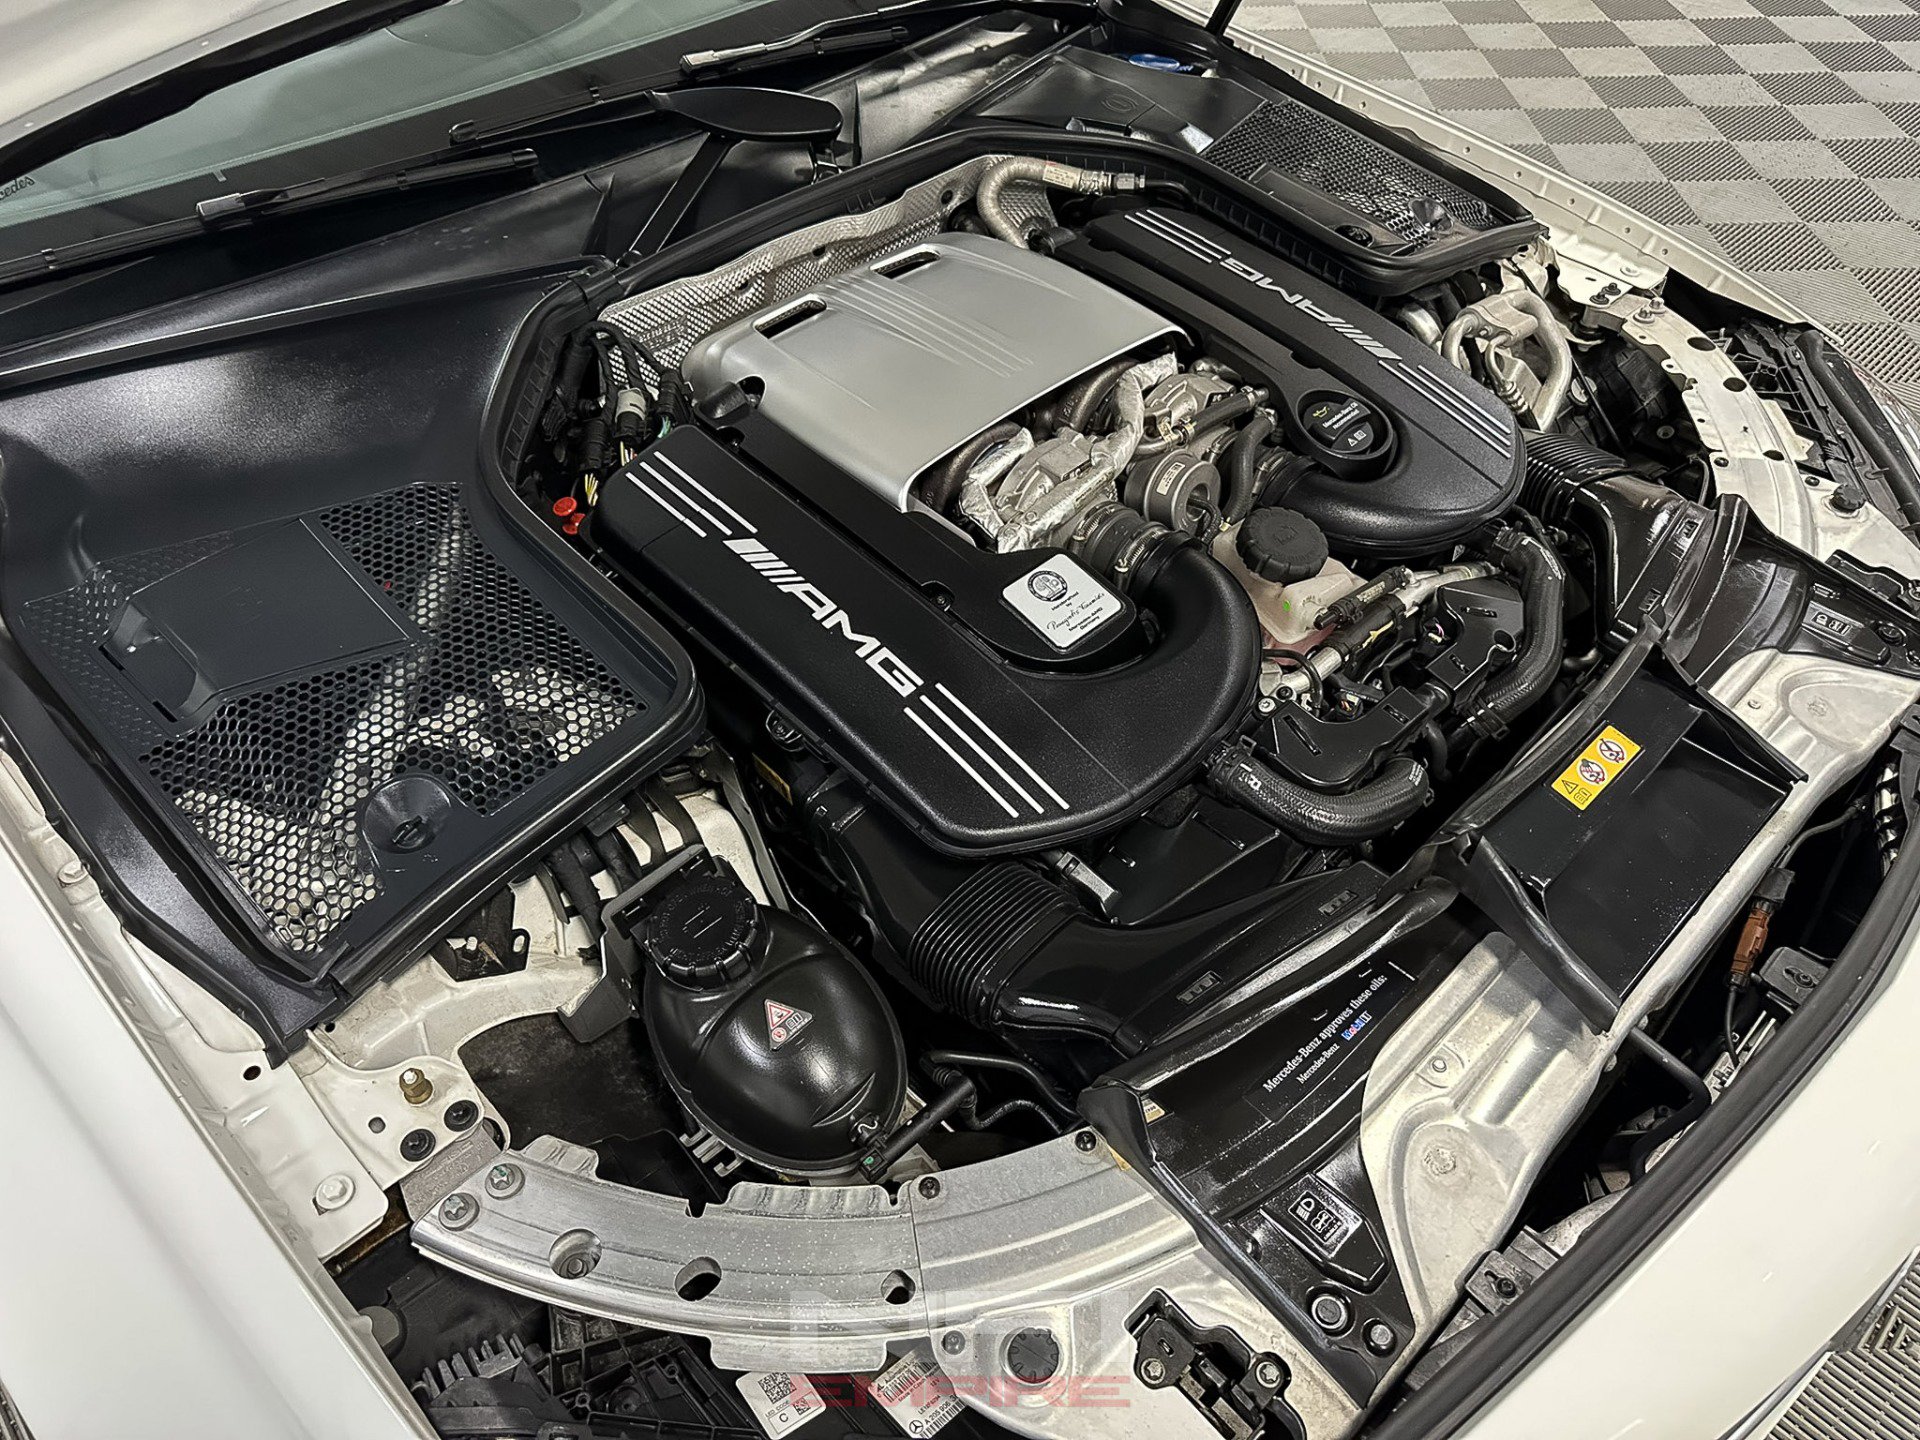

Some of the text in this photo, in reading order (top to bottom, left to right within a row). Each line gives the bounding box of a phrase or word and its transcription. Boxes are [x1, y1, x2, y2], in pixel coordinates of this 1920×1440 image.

[777, 583, 924, 697] AMG
[1263, 975, 1388, 1092] Mercedes-Benz approves these oils:
[1296, 1042, 1341, 1084] Mercedes-Benz
